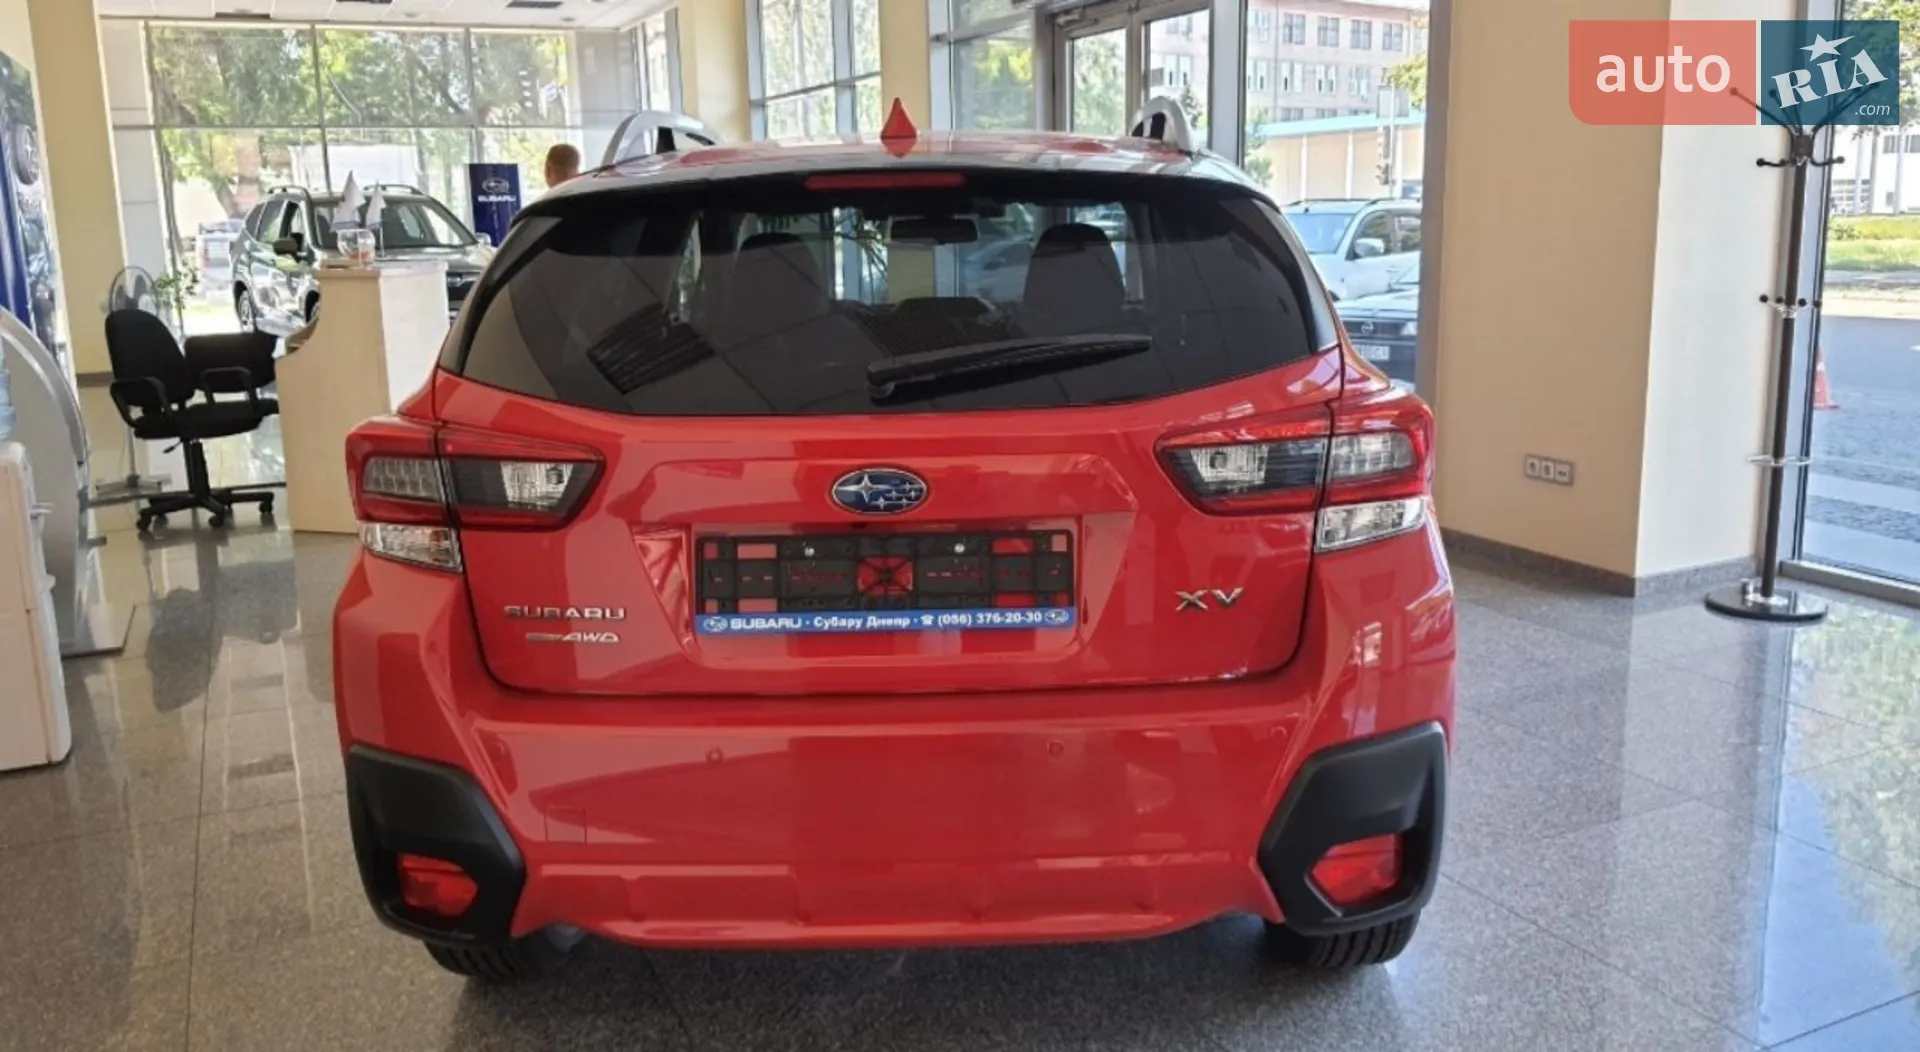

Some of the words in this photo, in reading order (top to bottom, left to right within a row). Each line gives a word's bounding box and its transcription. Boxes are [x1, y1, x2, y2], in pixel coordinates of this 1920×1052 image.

[477, 194, 517, 203] SUBARU
[1175, 587, 1244, 611] XV
[503, 604, 626, 620] SUBARU
[729, 616, 802, 630] SUBARU
[813, 615, 864, 629] Субару
[976, 610, 1042, 625] 376-20-30
[561, 632, 620, 643] AWD
